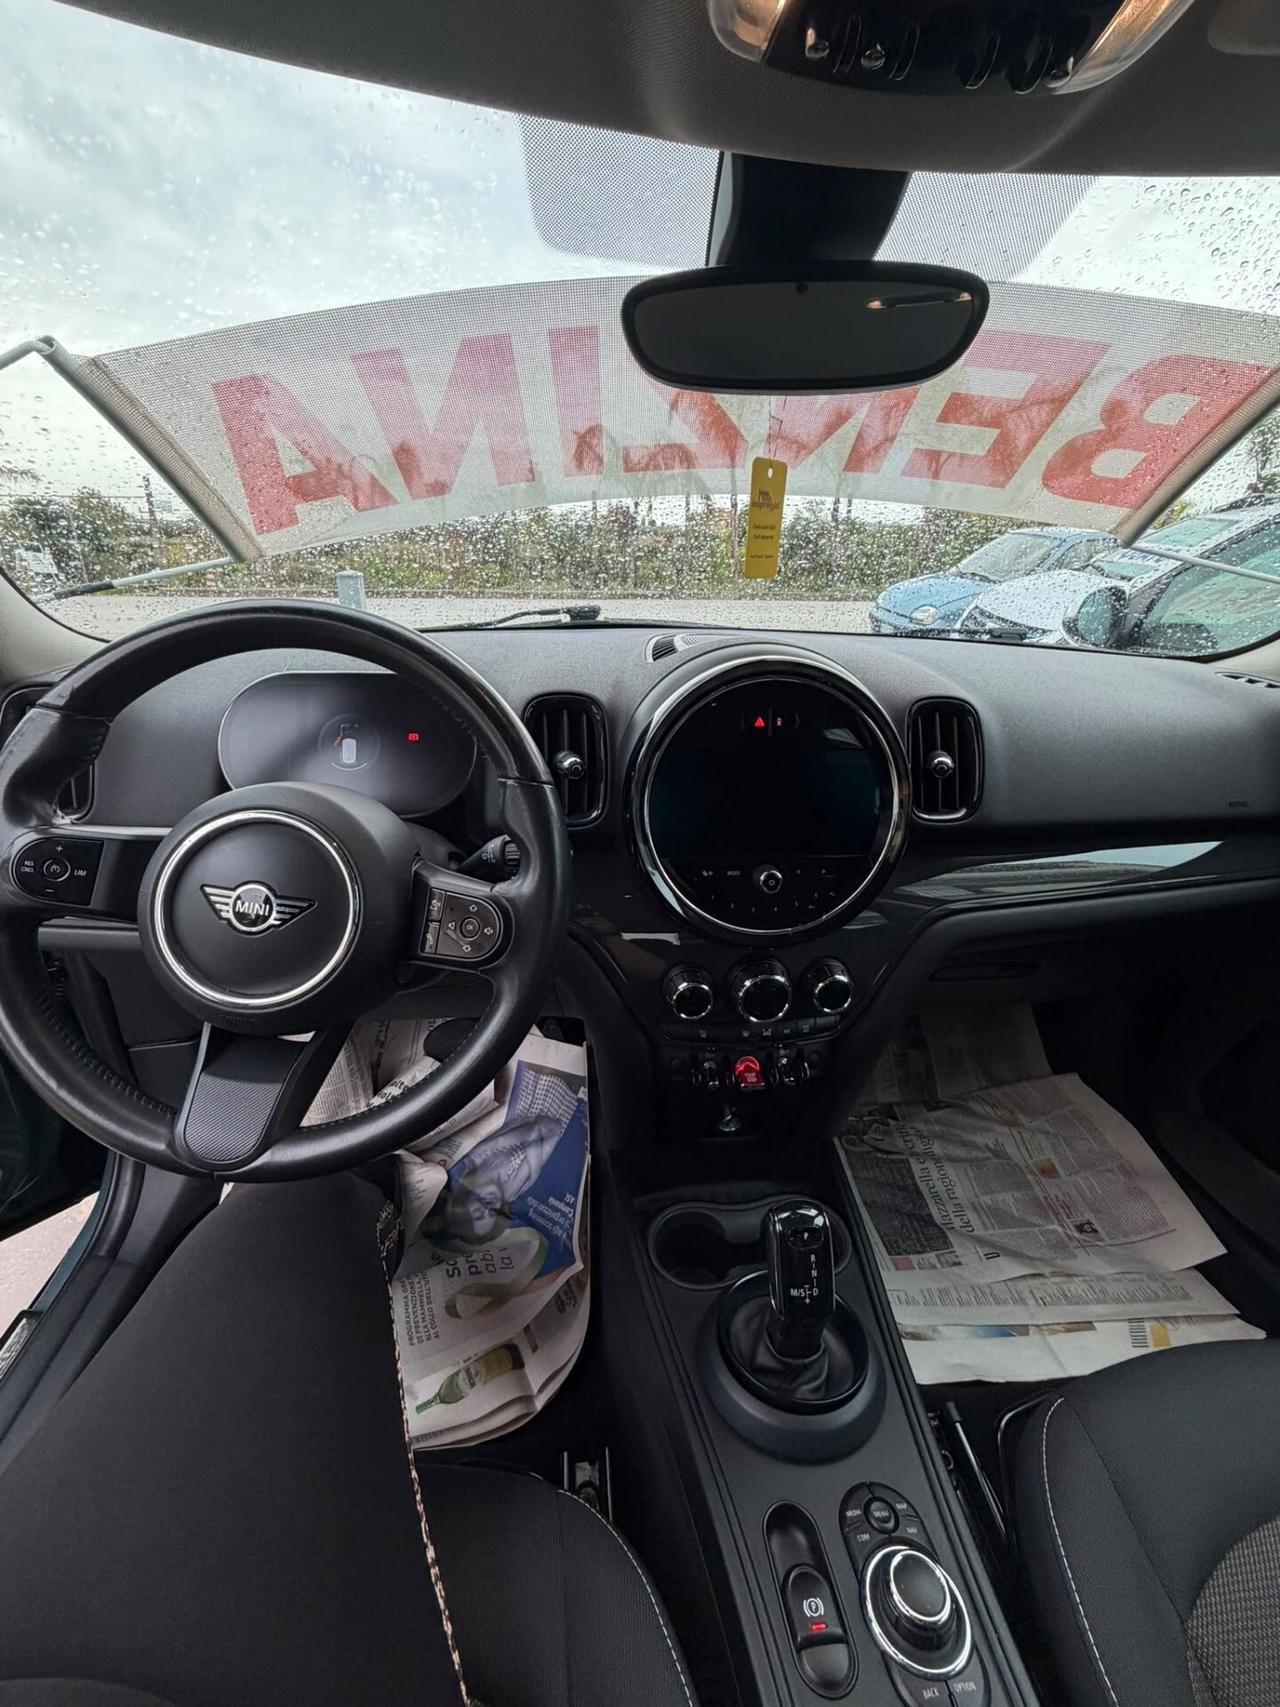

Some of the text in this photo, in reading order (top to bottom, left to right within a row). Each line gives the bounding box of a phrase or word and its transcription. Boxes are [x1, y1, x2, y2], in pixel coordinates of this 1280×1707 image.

[235, 900, 269, 916] MINI
[951, 1202, 975, 1233] della
[810, 1254, 816, 1262] R
[811, 1269, 817, 1278] N
[790, 1288, 805, 1297] M/S
[812, 1287, 819, 1296] D
[403, 1296, 415, 1346] PROGRAMMA
[427, 1306, 438, 1330] COLLO
[873, 1510, 890, 1519] MENU
[953, 1681, 977, 1693] OPTION
[922, 1688, 940, 1700] BACK
